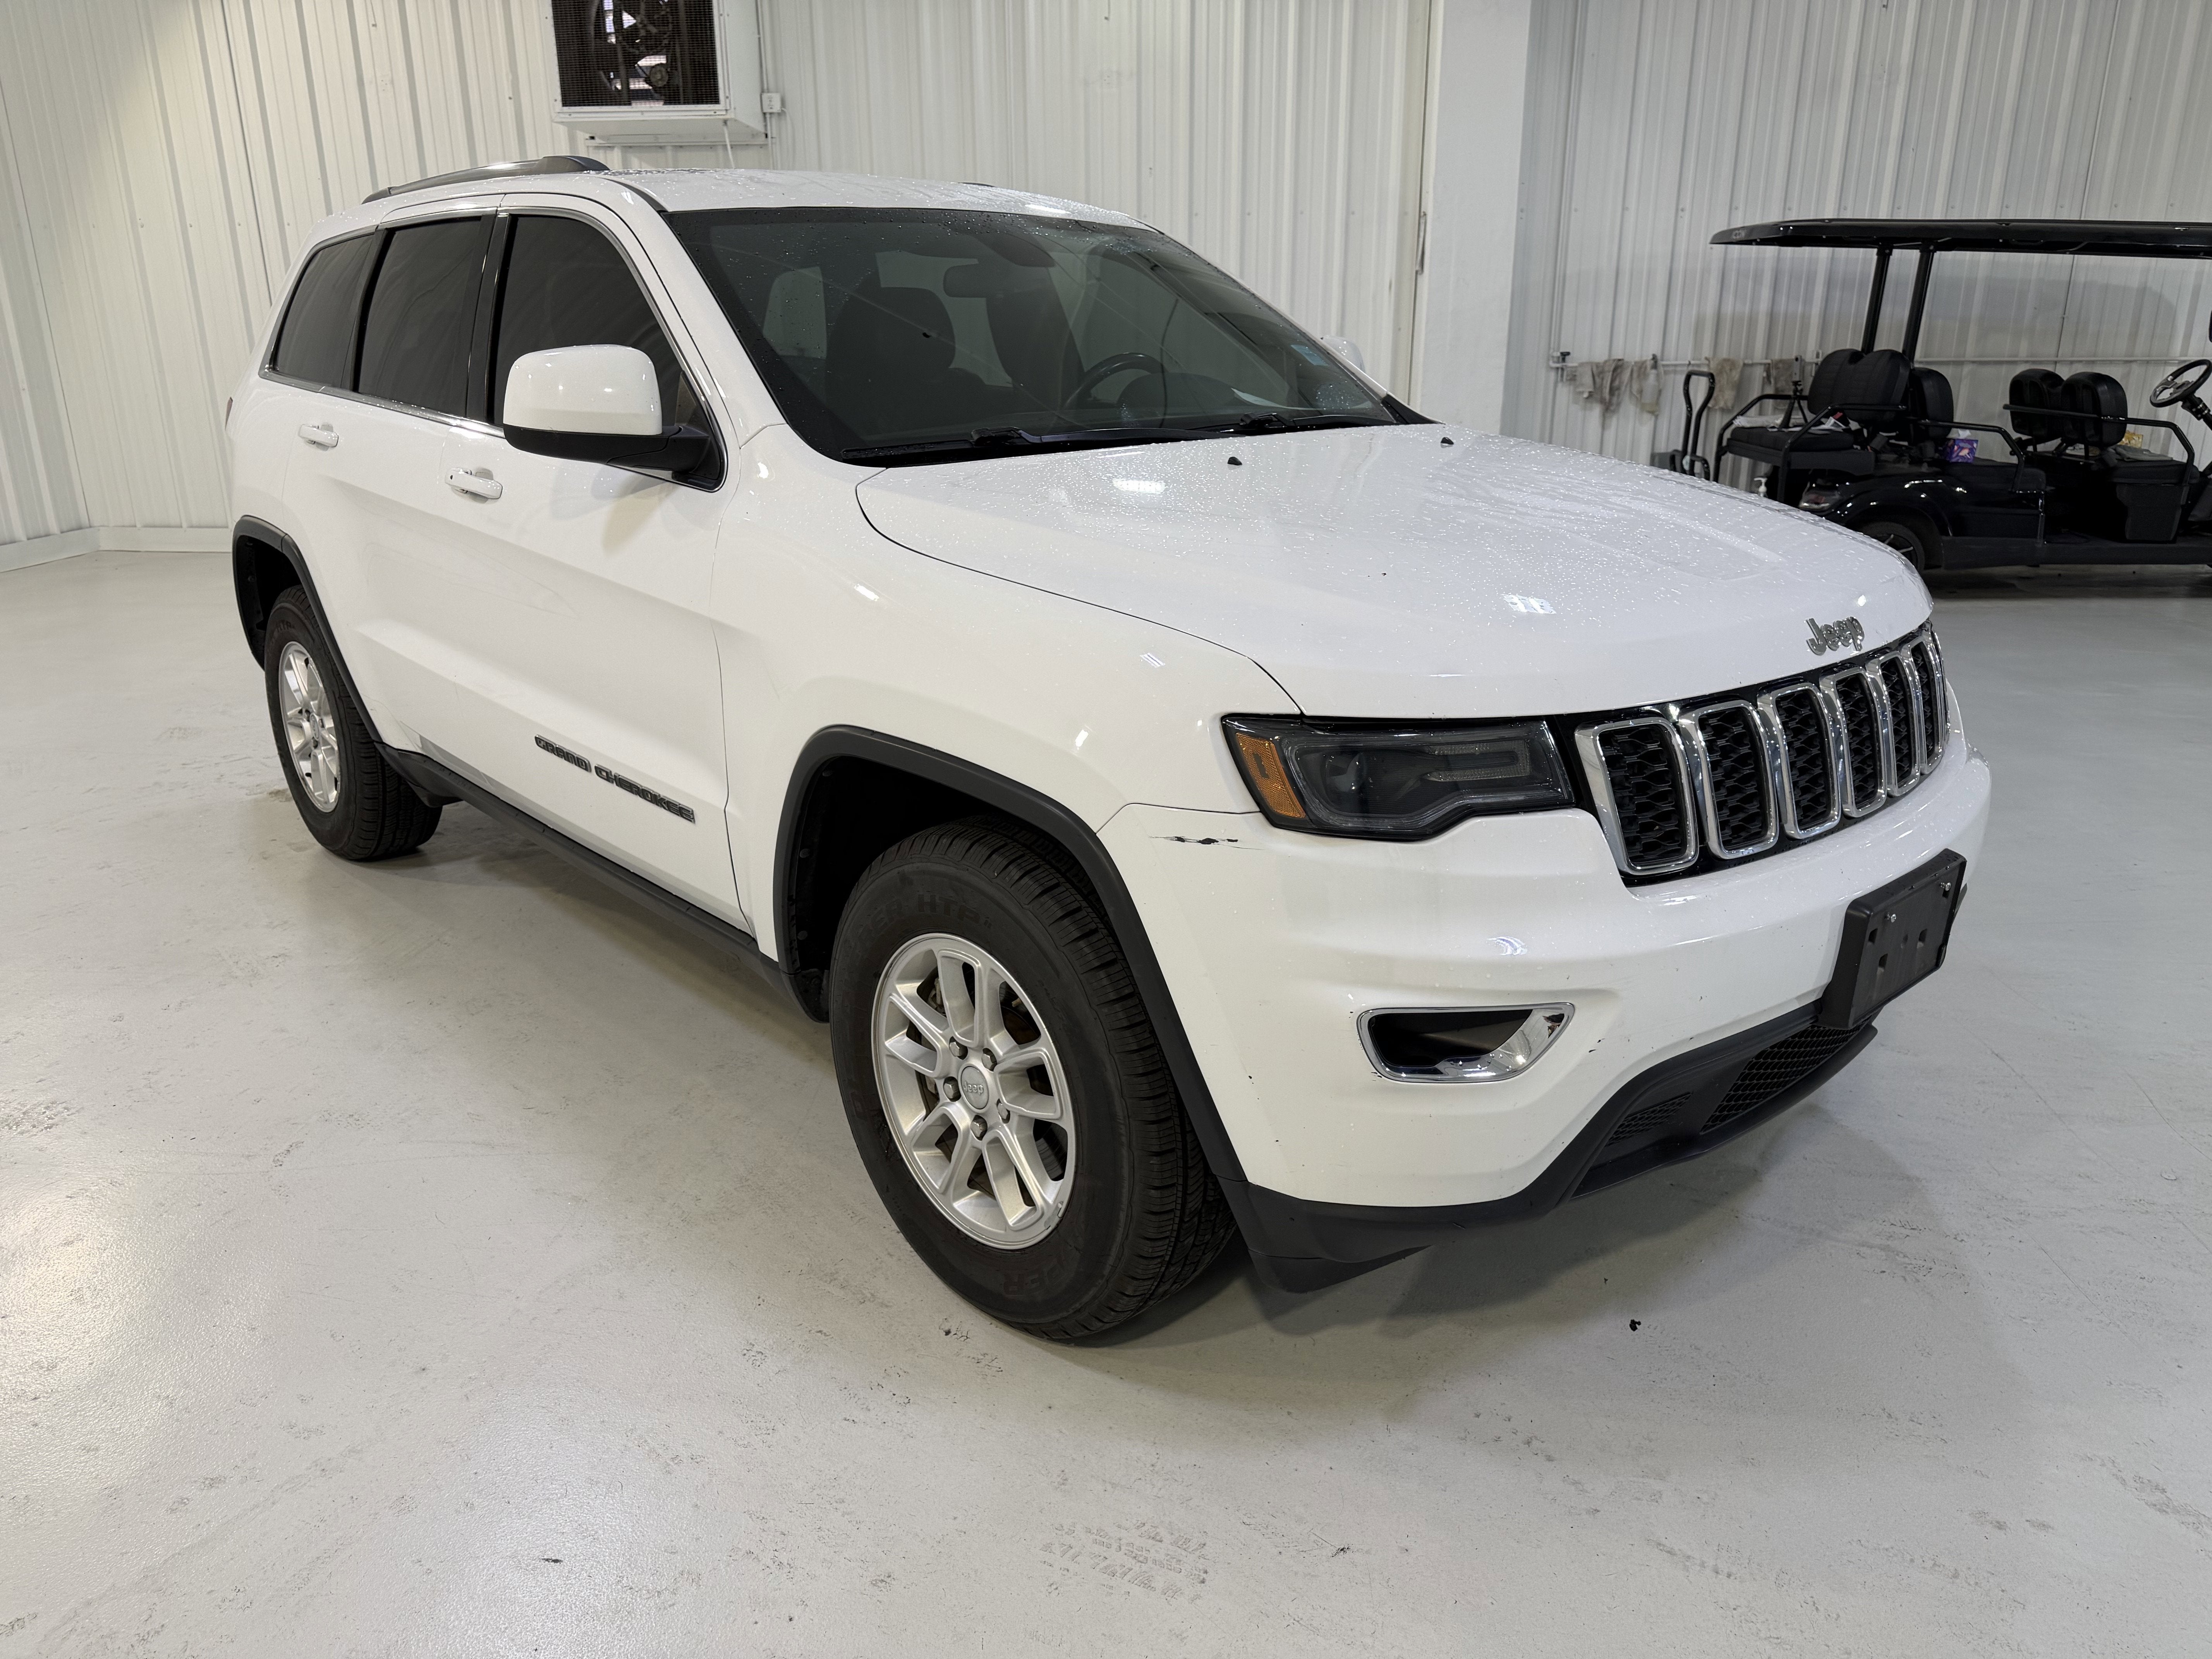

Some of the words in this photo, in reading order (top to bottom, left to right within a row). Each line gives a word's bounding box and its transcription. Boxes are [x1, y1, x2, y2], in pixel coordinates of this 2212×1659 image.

[1805, 617, 1865, 656] Jeep
[534, 734, 592, 773] GRAND
[594, 764, 696, 824] CHEROKEE
[918, 894, 980, 924] HTP
[963, 1080, 984, 1095] Jeep
